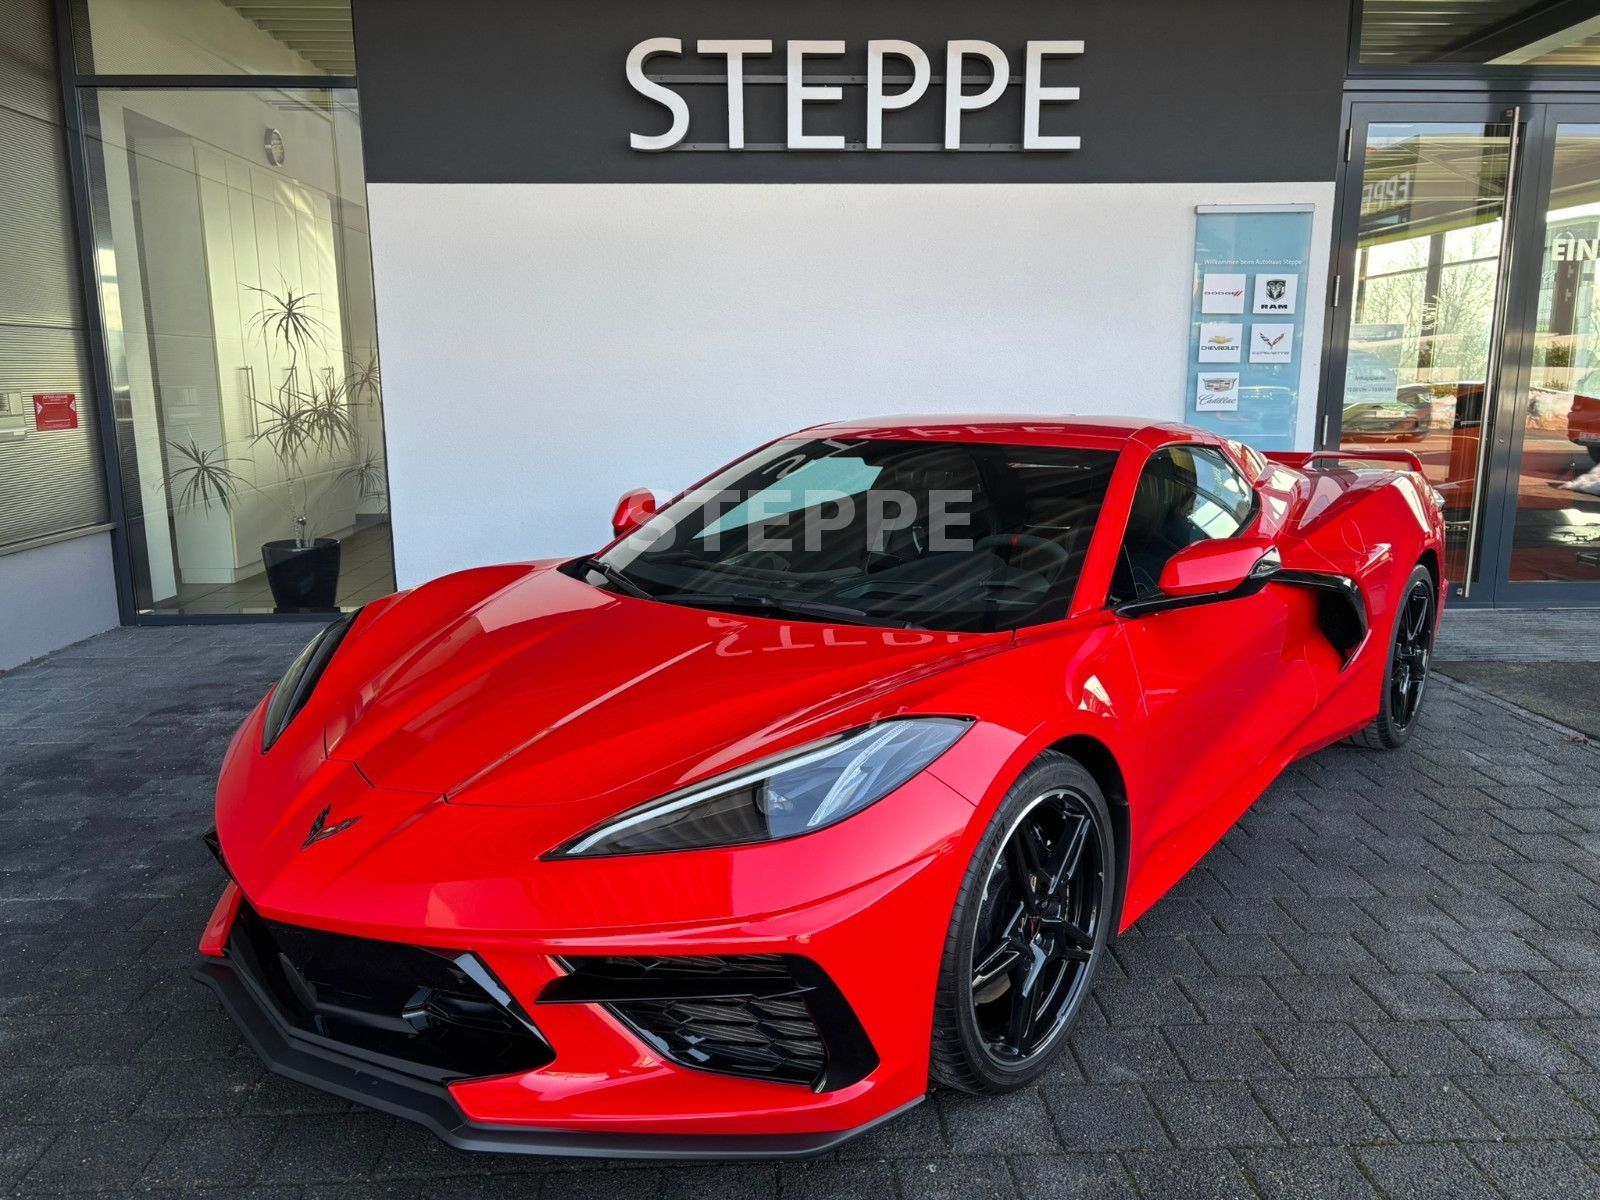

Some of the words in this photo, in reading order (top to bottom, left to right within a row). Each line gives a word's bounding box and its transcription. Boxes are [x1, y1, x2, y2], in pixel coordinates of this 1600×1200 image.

[626, 37, 1084, 150] STEPPE
[1551, 238, 1599, 261] EIN
[1198, 394, 1236, 405] Cadillac
